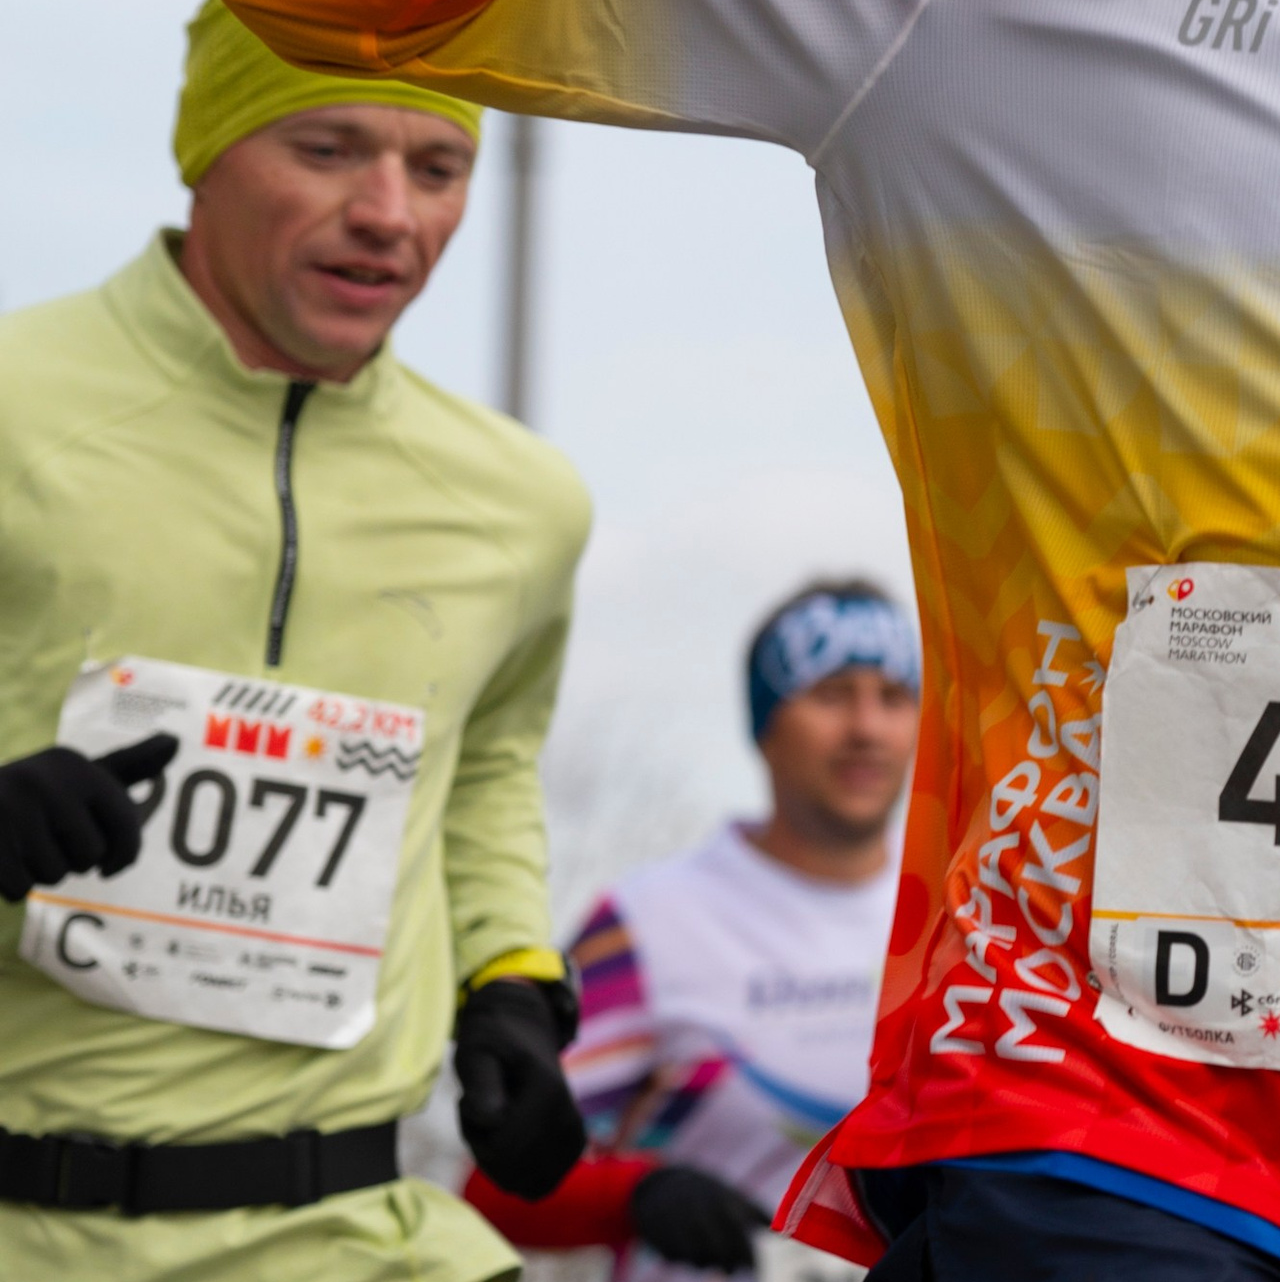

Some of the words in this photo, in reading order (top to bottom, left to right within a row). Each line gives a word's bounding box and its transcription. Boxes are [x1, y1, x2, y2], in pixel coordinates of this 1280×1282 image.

[1170, 606, 1273, 625] МОСКОВСКИЙ
[1169, 620, 1244, 637] МАРАФОН
[1168, 634, 1234, 650] MOSCOW
[1167, 648, 1248, 665] MARATHON
[176, 880, 273, 924] ИЛЬЯ
[1155, 929, 1210, 1008] D
[1158, 1022, 1236, 1045] ФУТБОЛКА
